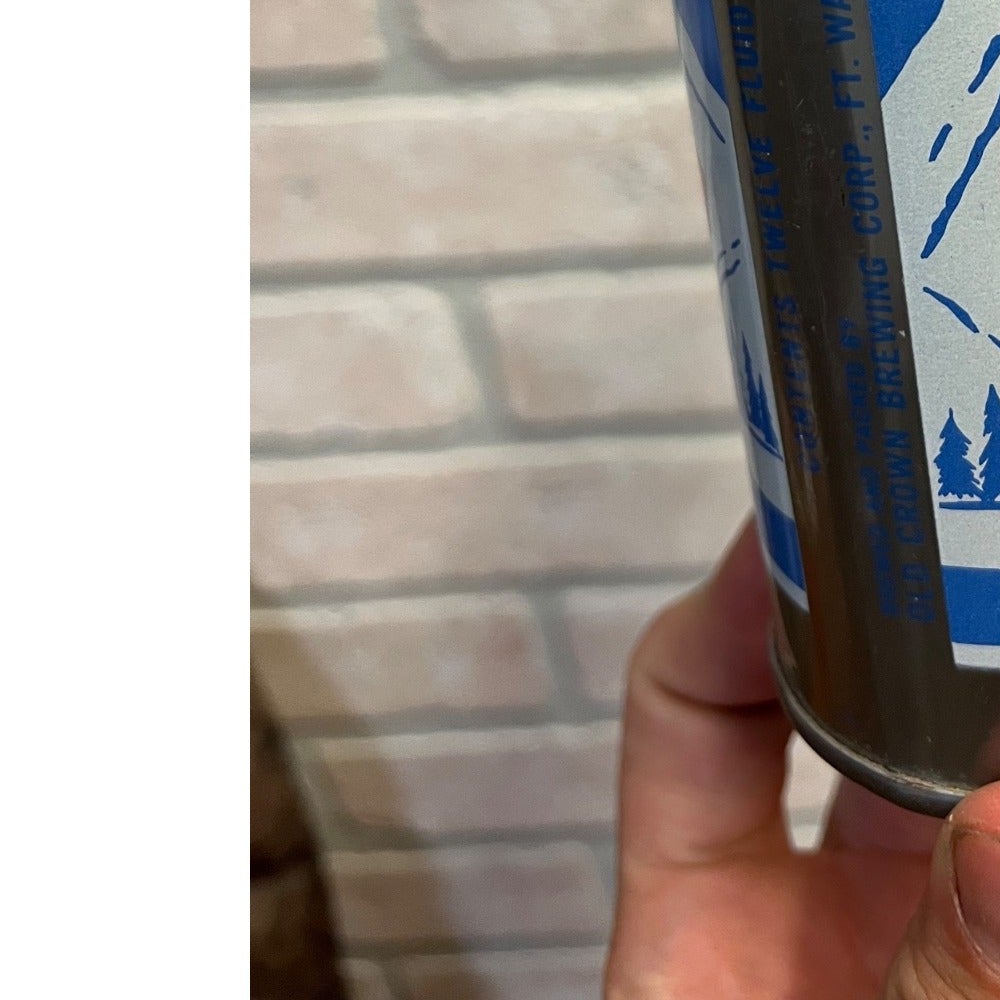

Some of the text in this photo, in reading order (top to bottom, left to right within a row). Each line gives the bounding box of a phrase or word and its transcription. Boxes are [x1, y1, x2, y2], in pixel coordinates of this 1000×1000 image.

[729, 5, 769, 114] FLUID
[831, 59, 866, 110] FT.
[749, 136, 791, 273] TWELVE
[858, 255, 908, 410] BREWING
[882, 429, 925, 545] CROWN
[902, 563, 937, 624] OLD
